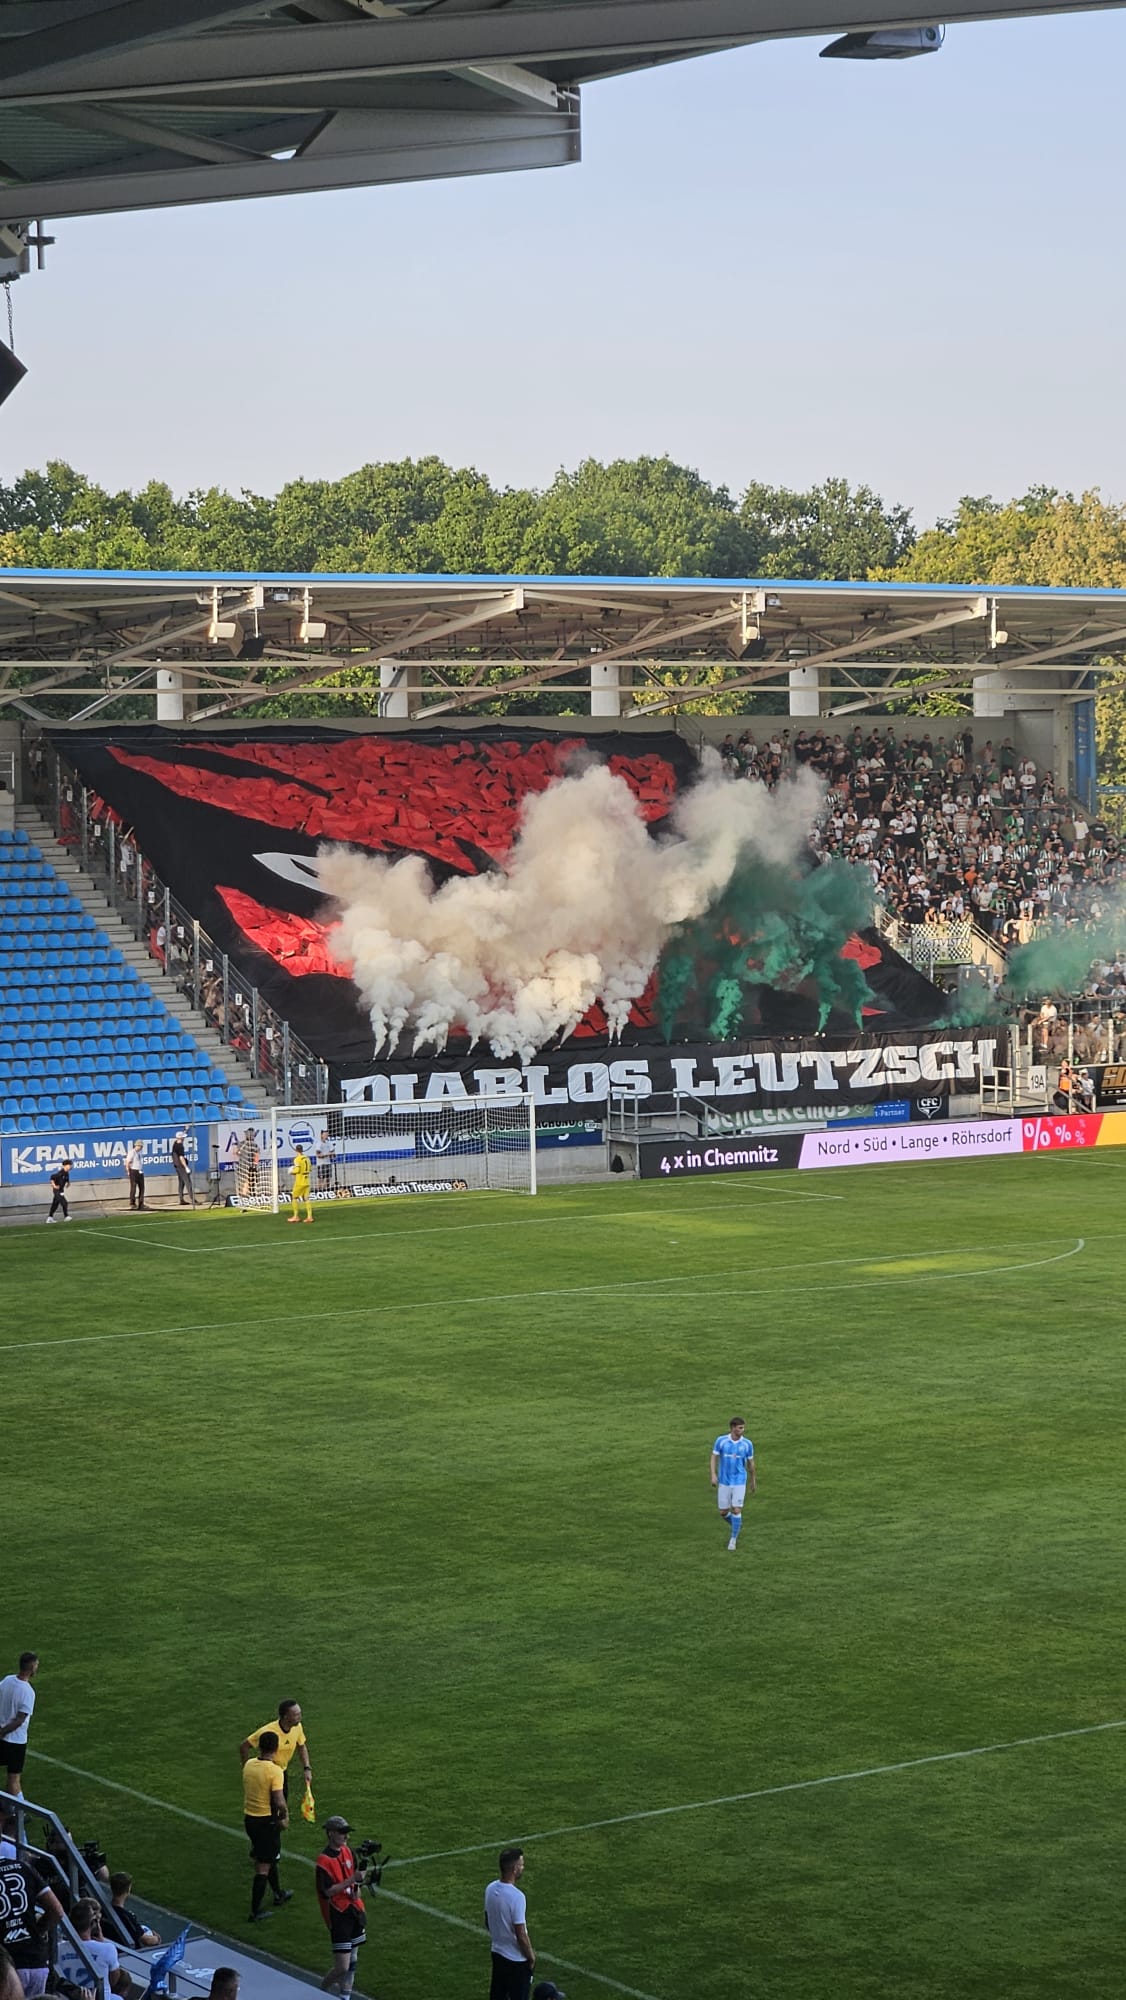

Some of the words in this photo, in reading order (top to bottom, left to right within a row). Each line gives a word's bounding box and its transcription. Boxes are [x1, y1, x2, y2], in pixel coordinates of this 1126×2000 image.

[341, 1060, 652, 1117] DIABLOS
[671, 1039, 997, 1097] LEUTZSCH
[1031, 1074, 1045, 1090] 19A
[920, 1097, 939, 1107] CFC
[818, 1140, 850, 1155] Nord
[863, 1137, 887, 1152] Süd
[901, 1135, 939, 1152] Lange
[952, 1127, 1012, 1146] Röhrsdorf
[102, 1158, 120, 1168] UND
[660, 1157, 671, 1174] 4
[674, 1156, 684, 1169] x
[686, 1150, 701, 1168] in
[704, 1145, 779, 1167] Chemnitz
[353, 1182, 410, 1197] Eisenbach
